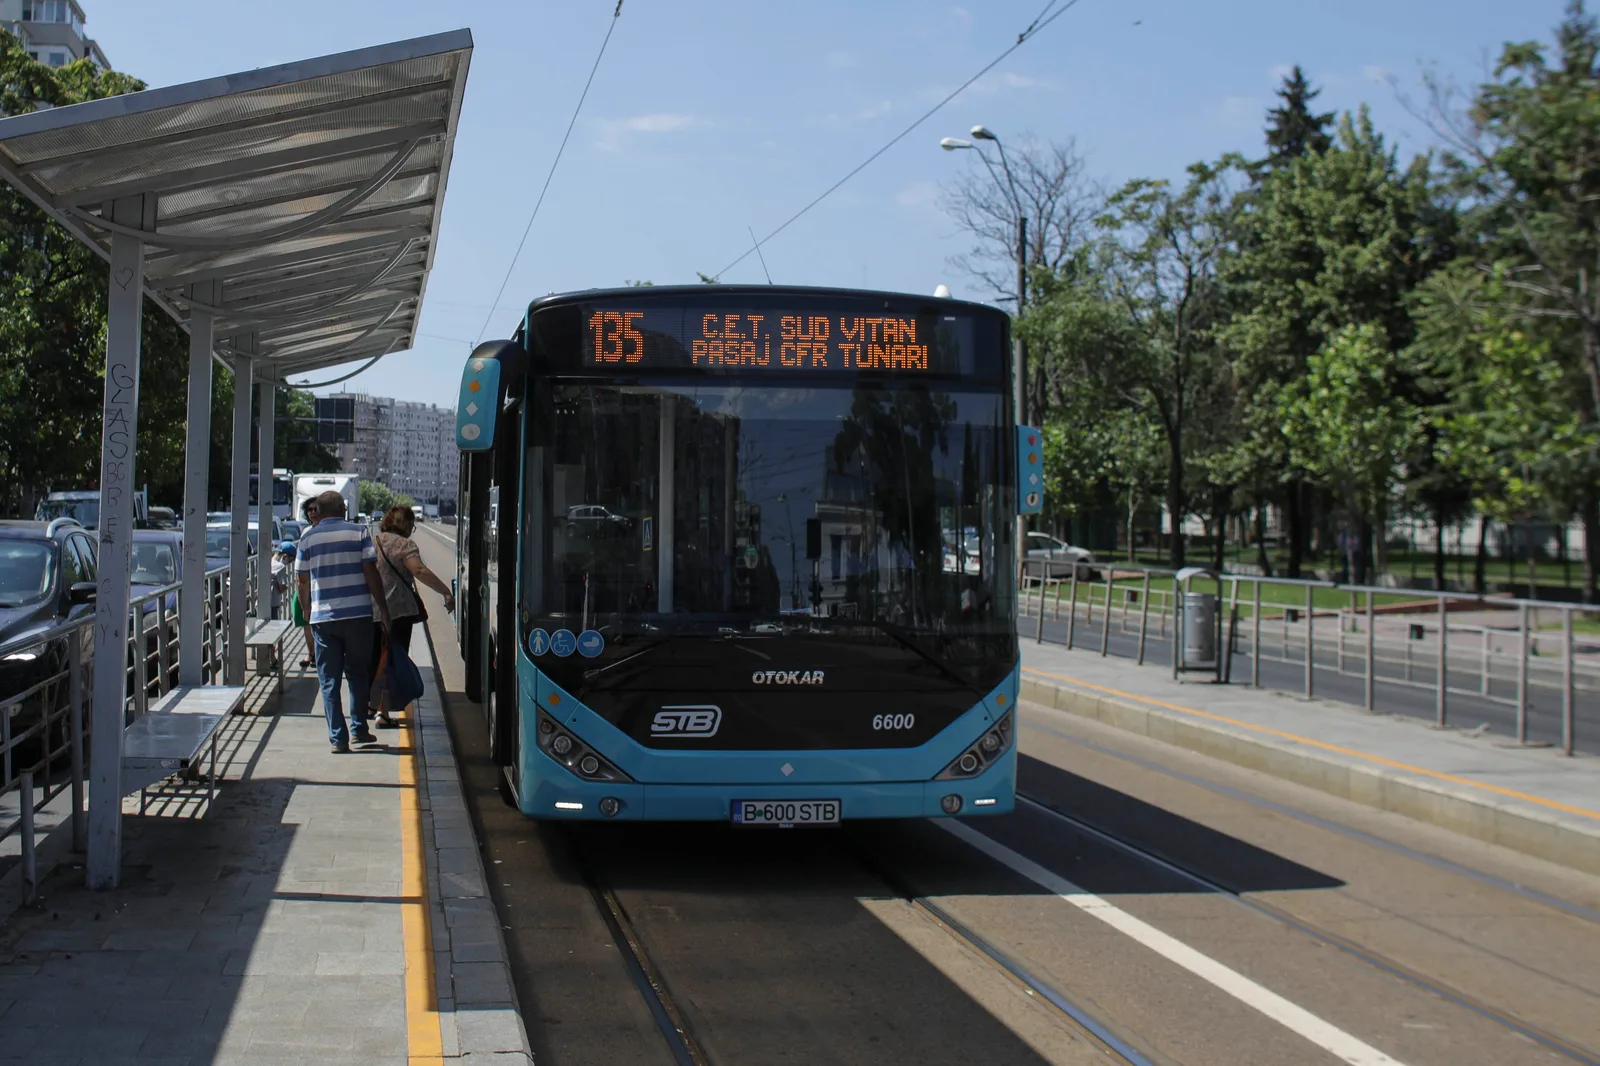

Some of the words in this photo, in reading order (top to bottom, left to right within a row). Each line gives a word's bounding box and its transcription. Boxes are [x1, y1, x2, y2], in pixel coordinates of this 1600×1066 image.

[588, 311, 644, 363] 135
[702, 313, 770, 338] C.E.T.
[781, 316, 829, 341] SUD
[840, 317, 916, 343] VITAN
[692, 340, 770, 366] PASAJ
[780, 342, 828, 367] CFR
[838, 343, 928, 369] TUNARI
[752, 671, 824, 685] OTOKAR
[650, 711, 715, 732] STB
[872, 713, 915, 731] 6600
[799, 803, 836, 821] STB
